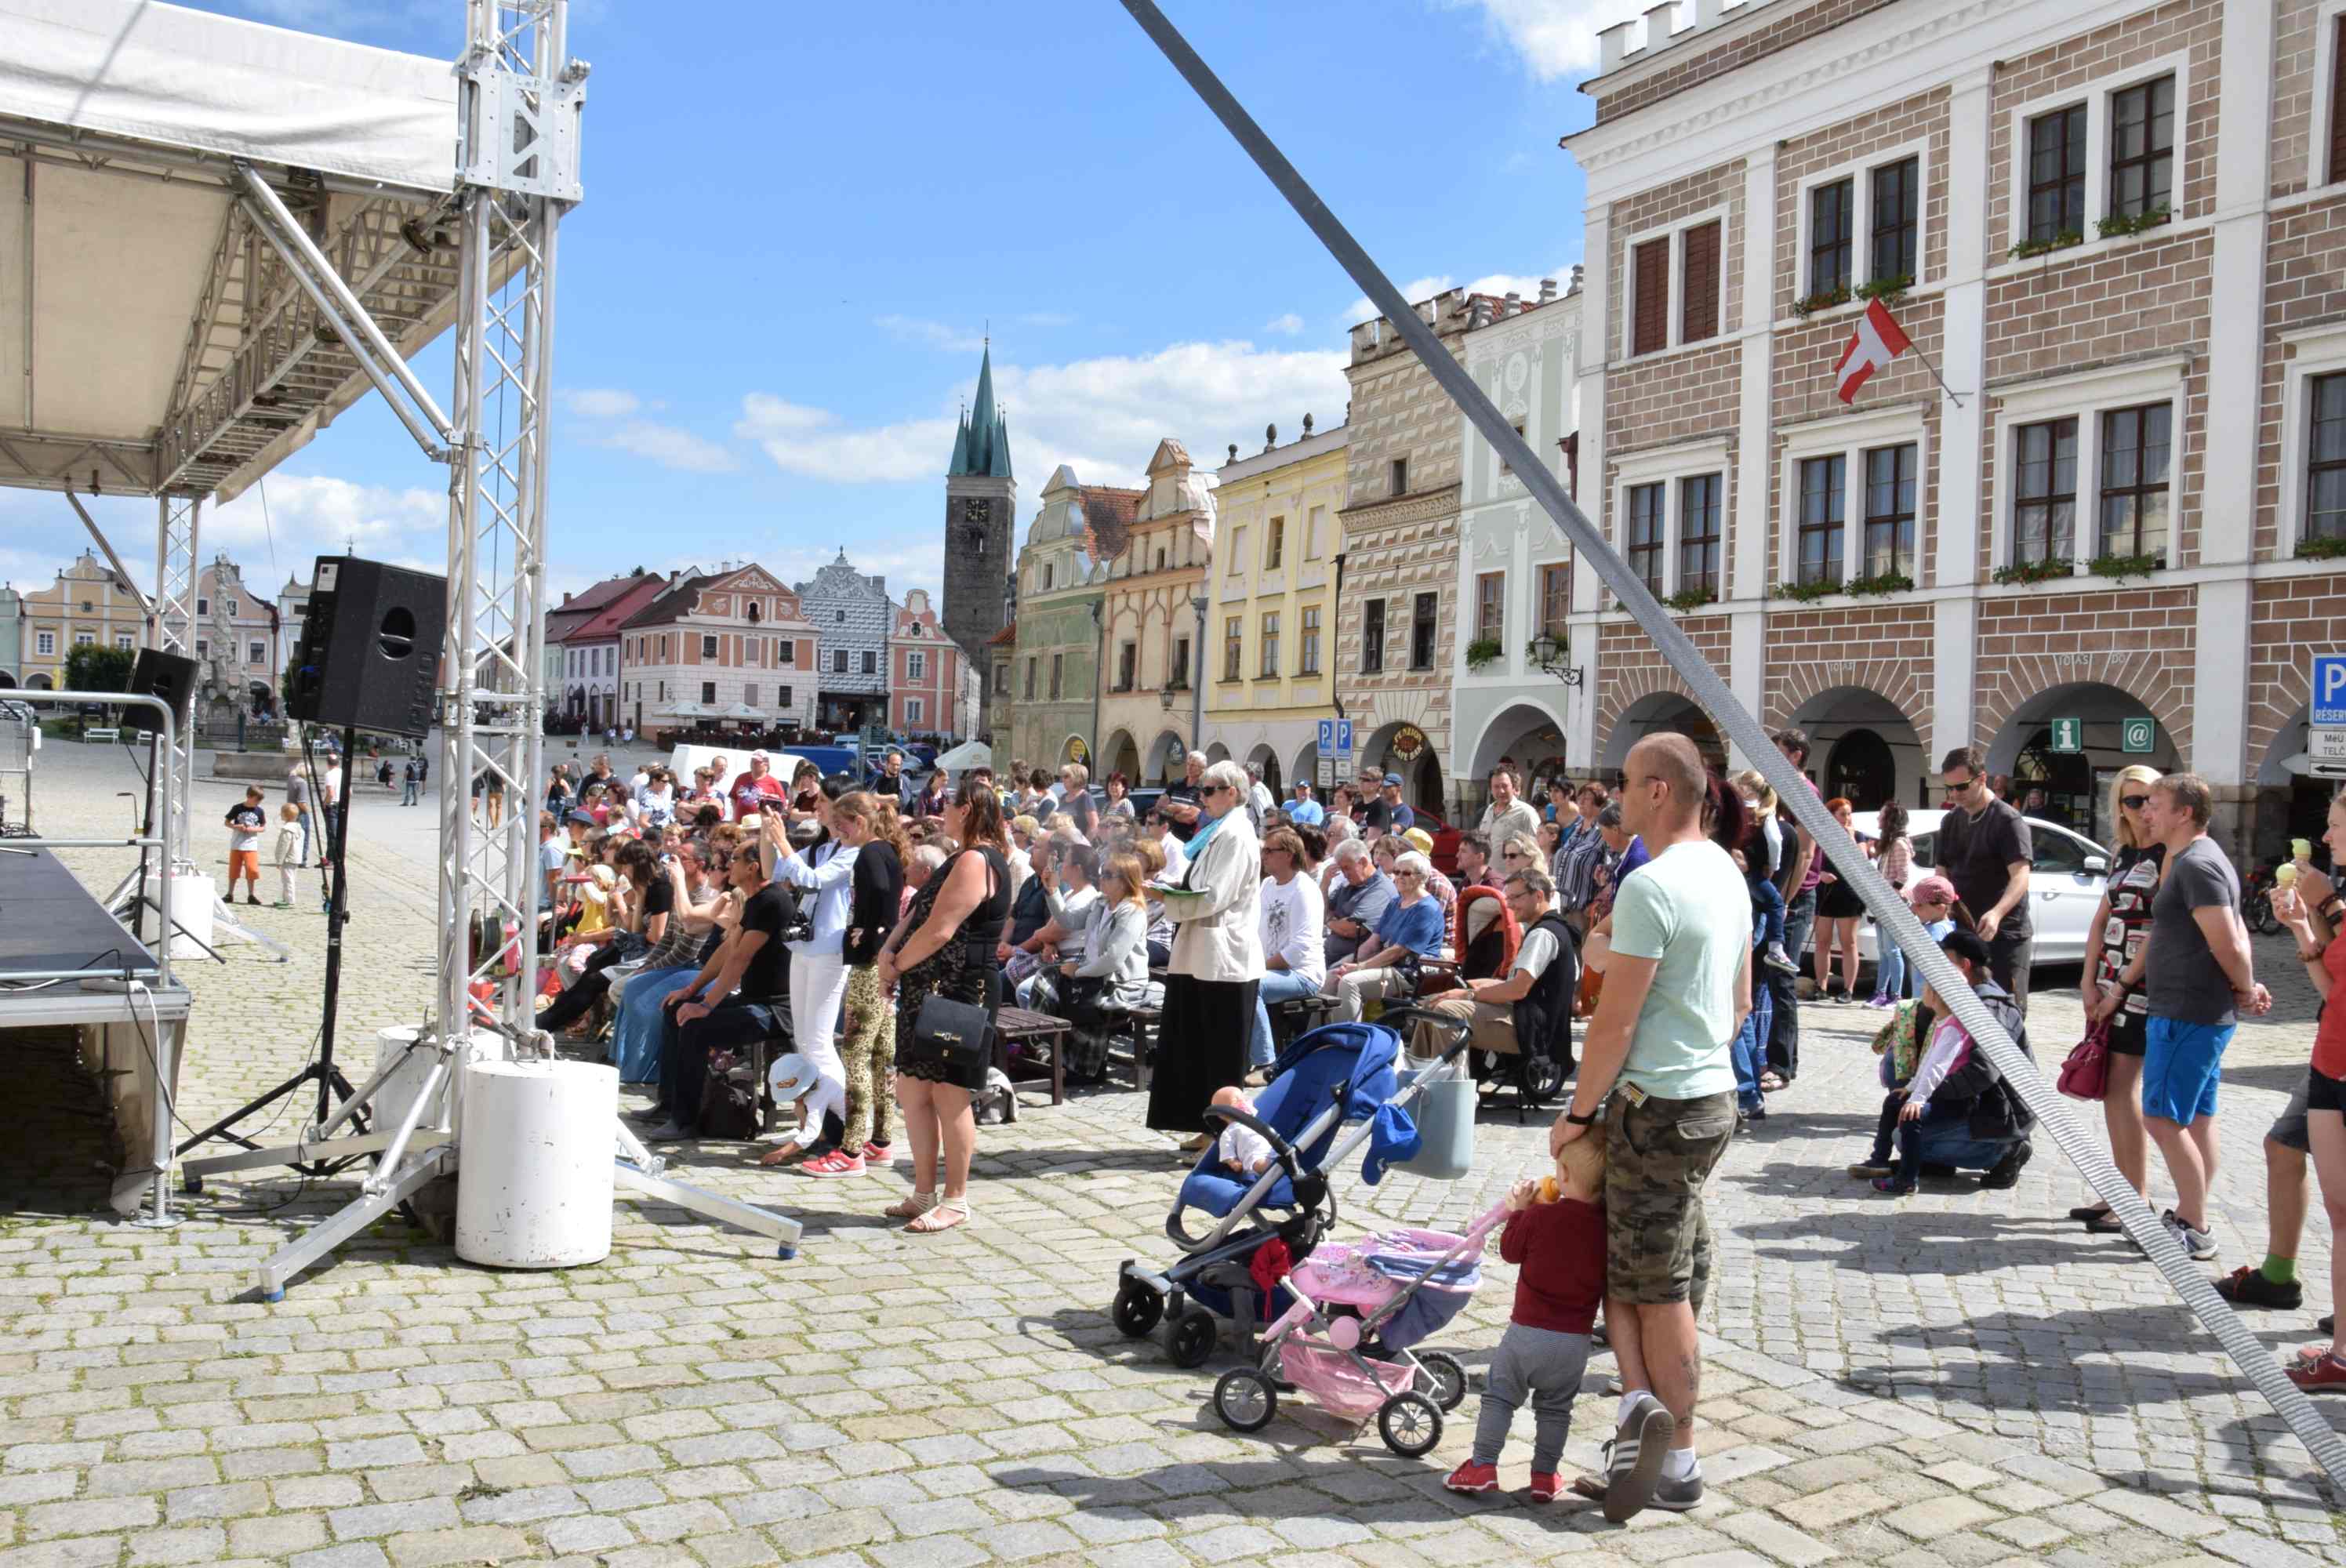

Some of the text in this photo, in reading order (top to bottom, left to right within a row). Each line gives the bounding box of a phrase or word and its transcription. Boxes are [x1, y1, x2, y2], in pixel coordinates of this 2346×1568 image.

[2325, 663, 2346, 702] P
[2315, 706, 2346, 721] RÉSER
[1321, 724, 1330, 745] P
[1340, 724, 1348, 745] P
[2127, 723, 2149, 747] @
